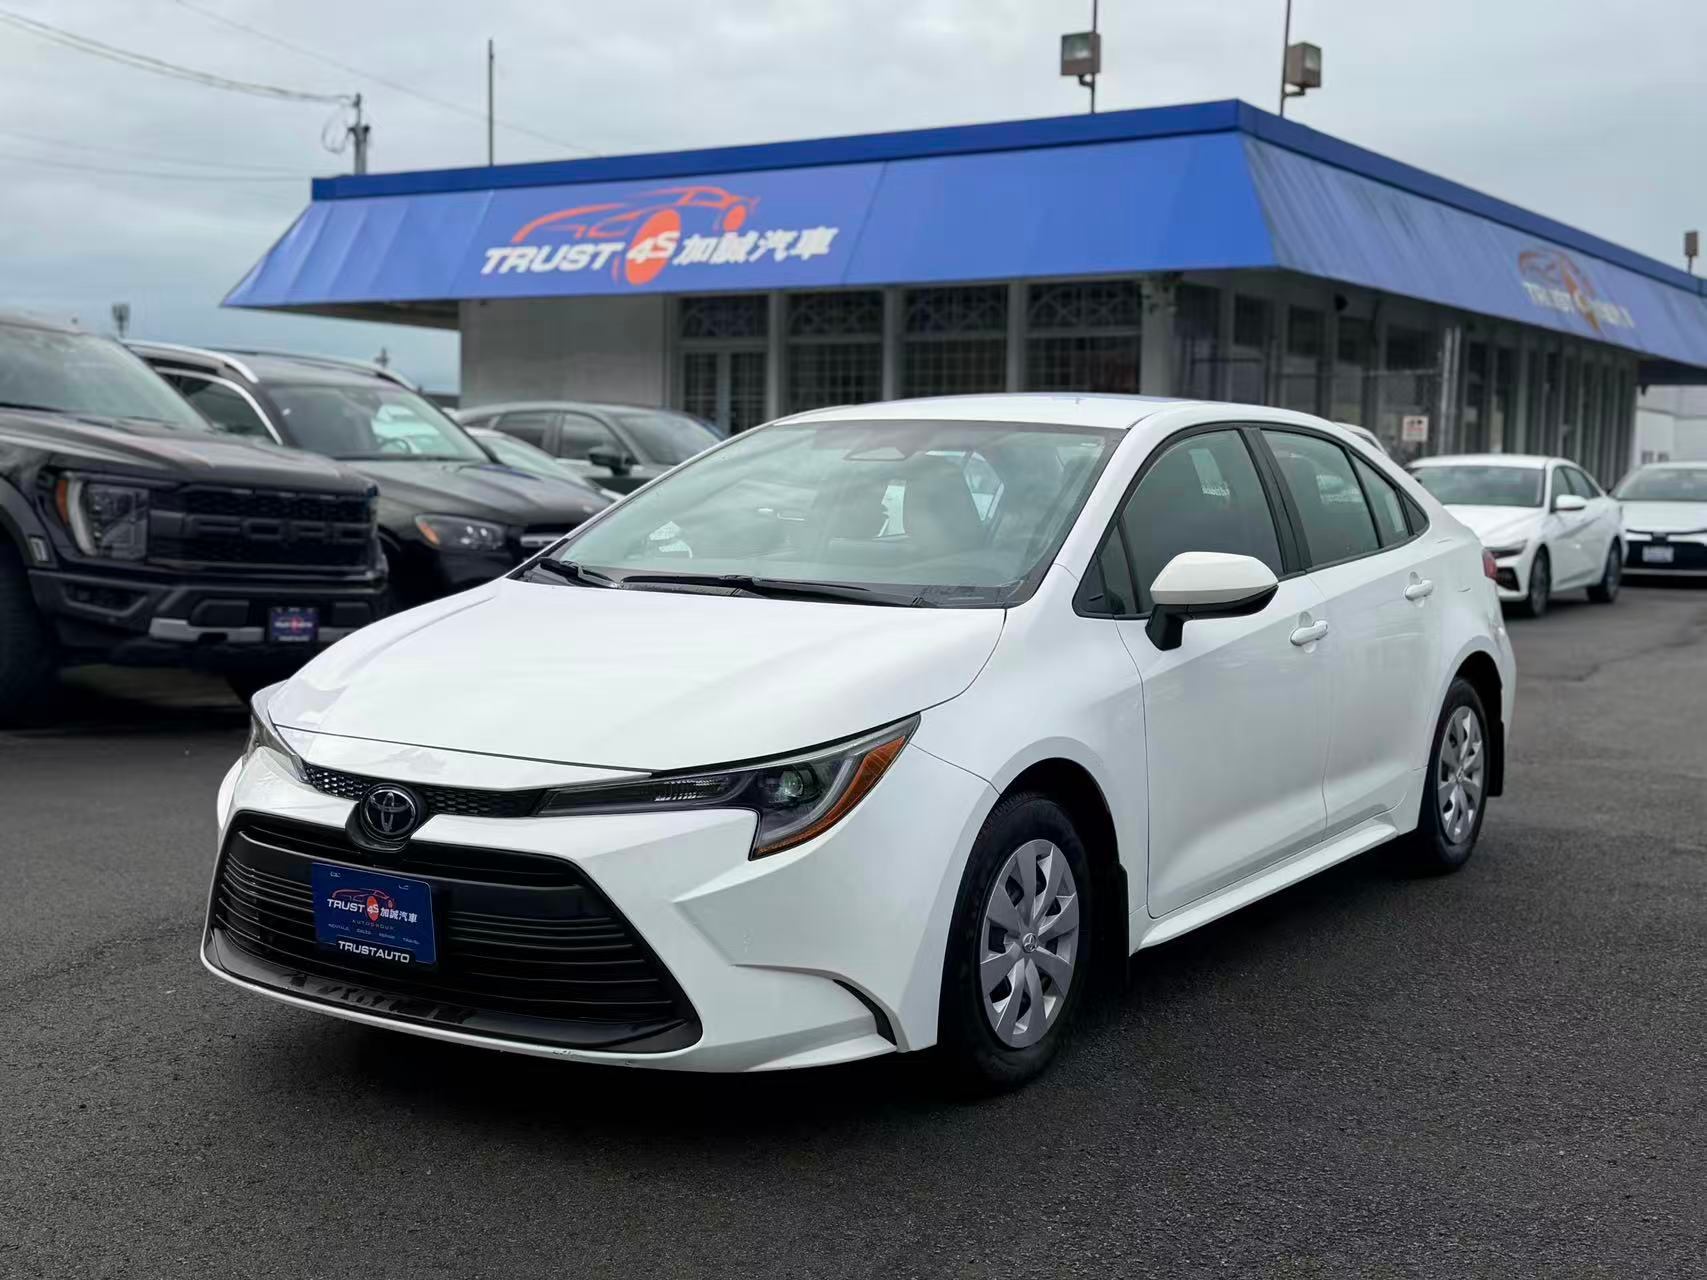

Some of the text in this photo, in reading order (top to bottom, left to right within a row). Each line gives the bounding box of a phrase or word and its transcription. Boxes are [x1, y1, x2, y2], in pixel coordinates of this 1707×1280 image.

[481, 242, 625, 274] TRUST
[626, 231, 679, 263] 4S
[327, 899, 365, 913] TRUST
[367, 904, 379, 914] 4S
[338, 940, 410, 963] TRUSTAUTO
